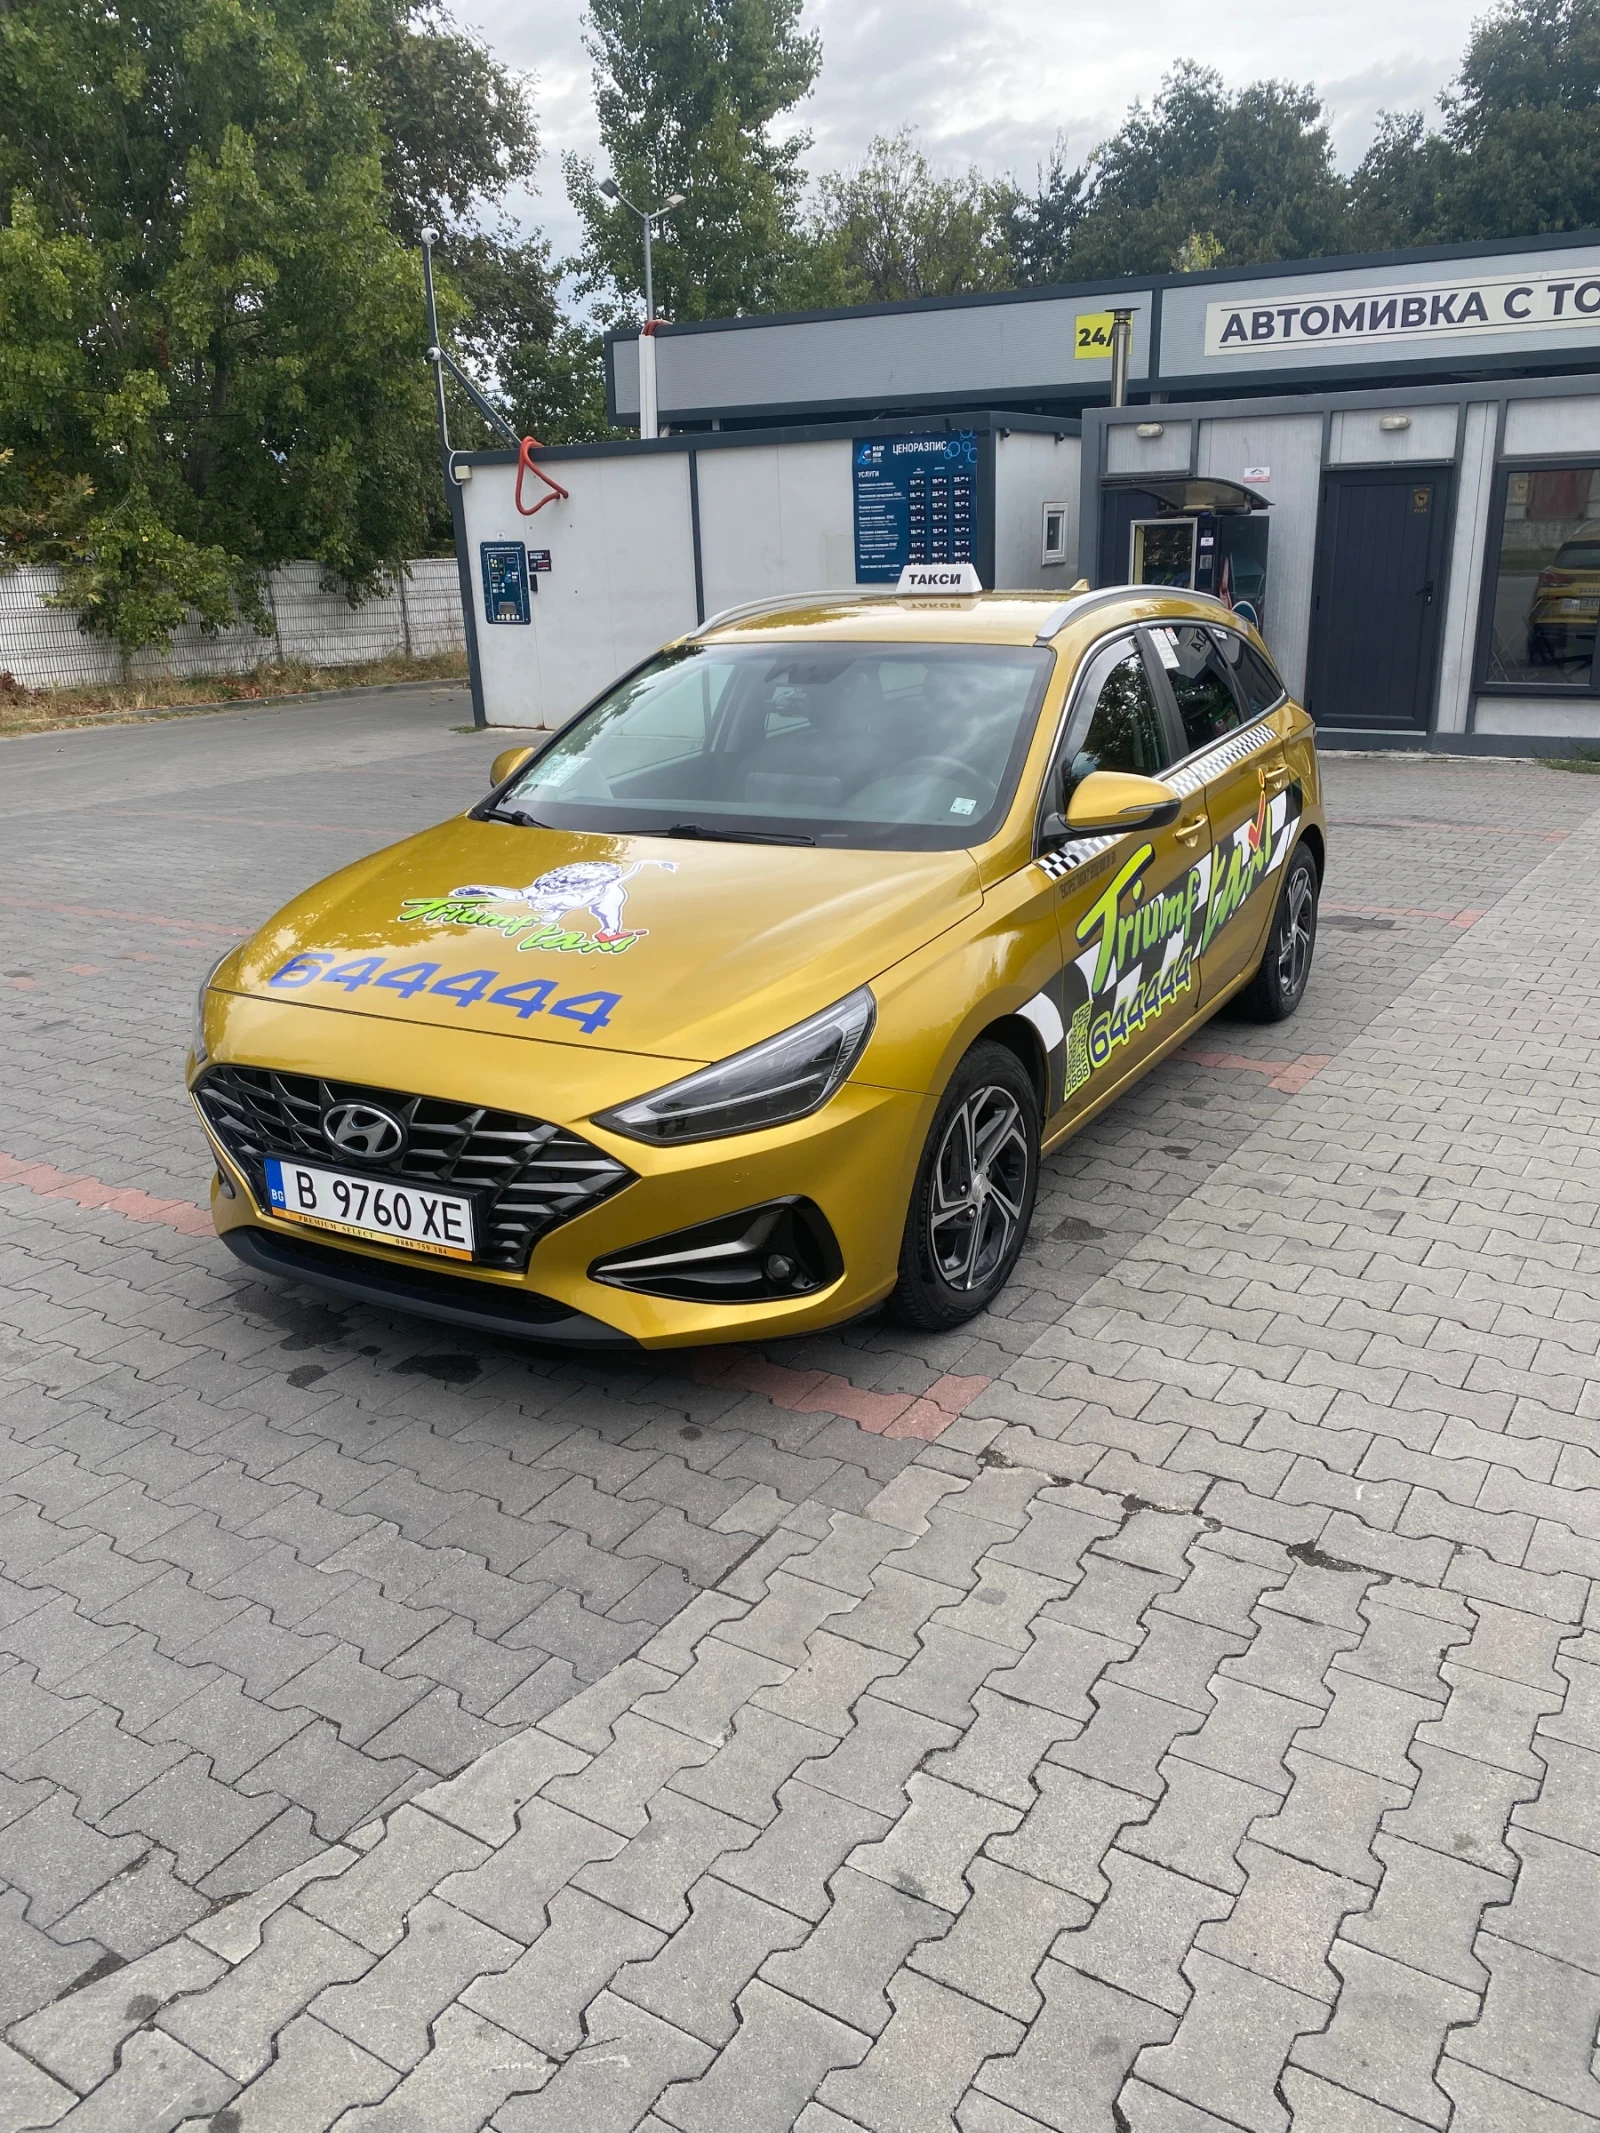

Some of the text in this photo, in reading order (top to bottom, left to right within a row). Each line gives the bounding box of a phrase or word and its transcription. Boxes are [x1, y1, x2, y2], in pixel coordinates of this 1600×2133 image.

[1220, 280, 1600, 343] АВТОМИВКА С ТО
[1078, 326, 1113, 347] 24/
[892, 441, 947, 455] ЦЕНОРАЗПИС
[858, 470, 879, 478] УСЛУГИ
[909, 574, 961, 584] ТАКСИ
[400, 897, 541, 936] Triumf
[1076, 843, 1200, 993] Triumf
[268, 953, 623, 1034] 644444
[1090, 947, 1191, 1064] 644444
[1073, 1004, 1090, 1028] 052
[1065, 1064, 1089, 1094] 0898
[271, 1188, 284, 1202] BG
[296, 1170, 465, 1244] B 9760 XE
[298, 1215, 374, 1239] PREMIUM SELECT
[395, 1238, 447, 1255] 0888 759 184
